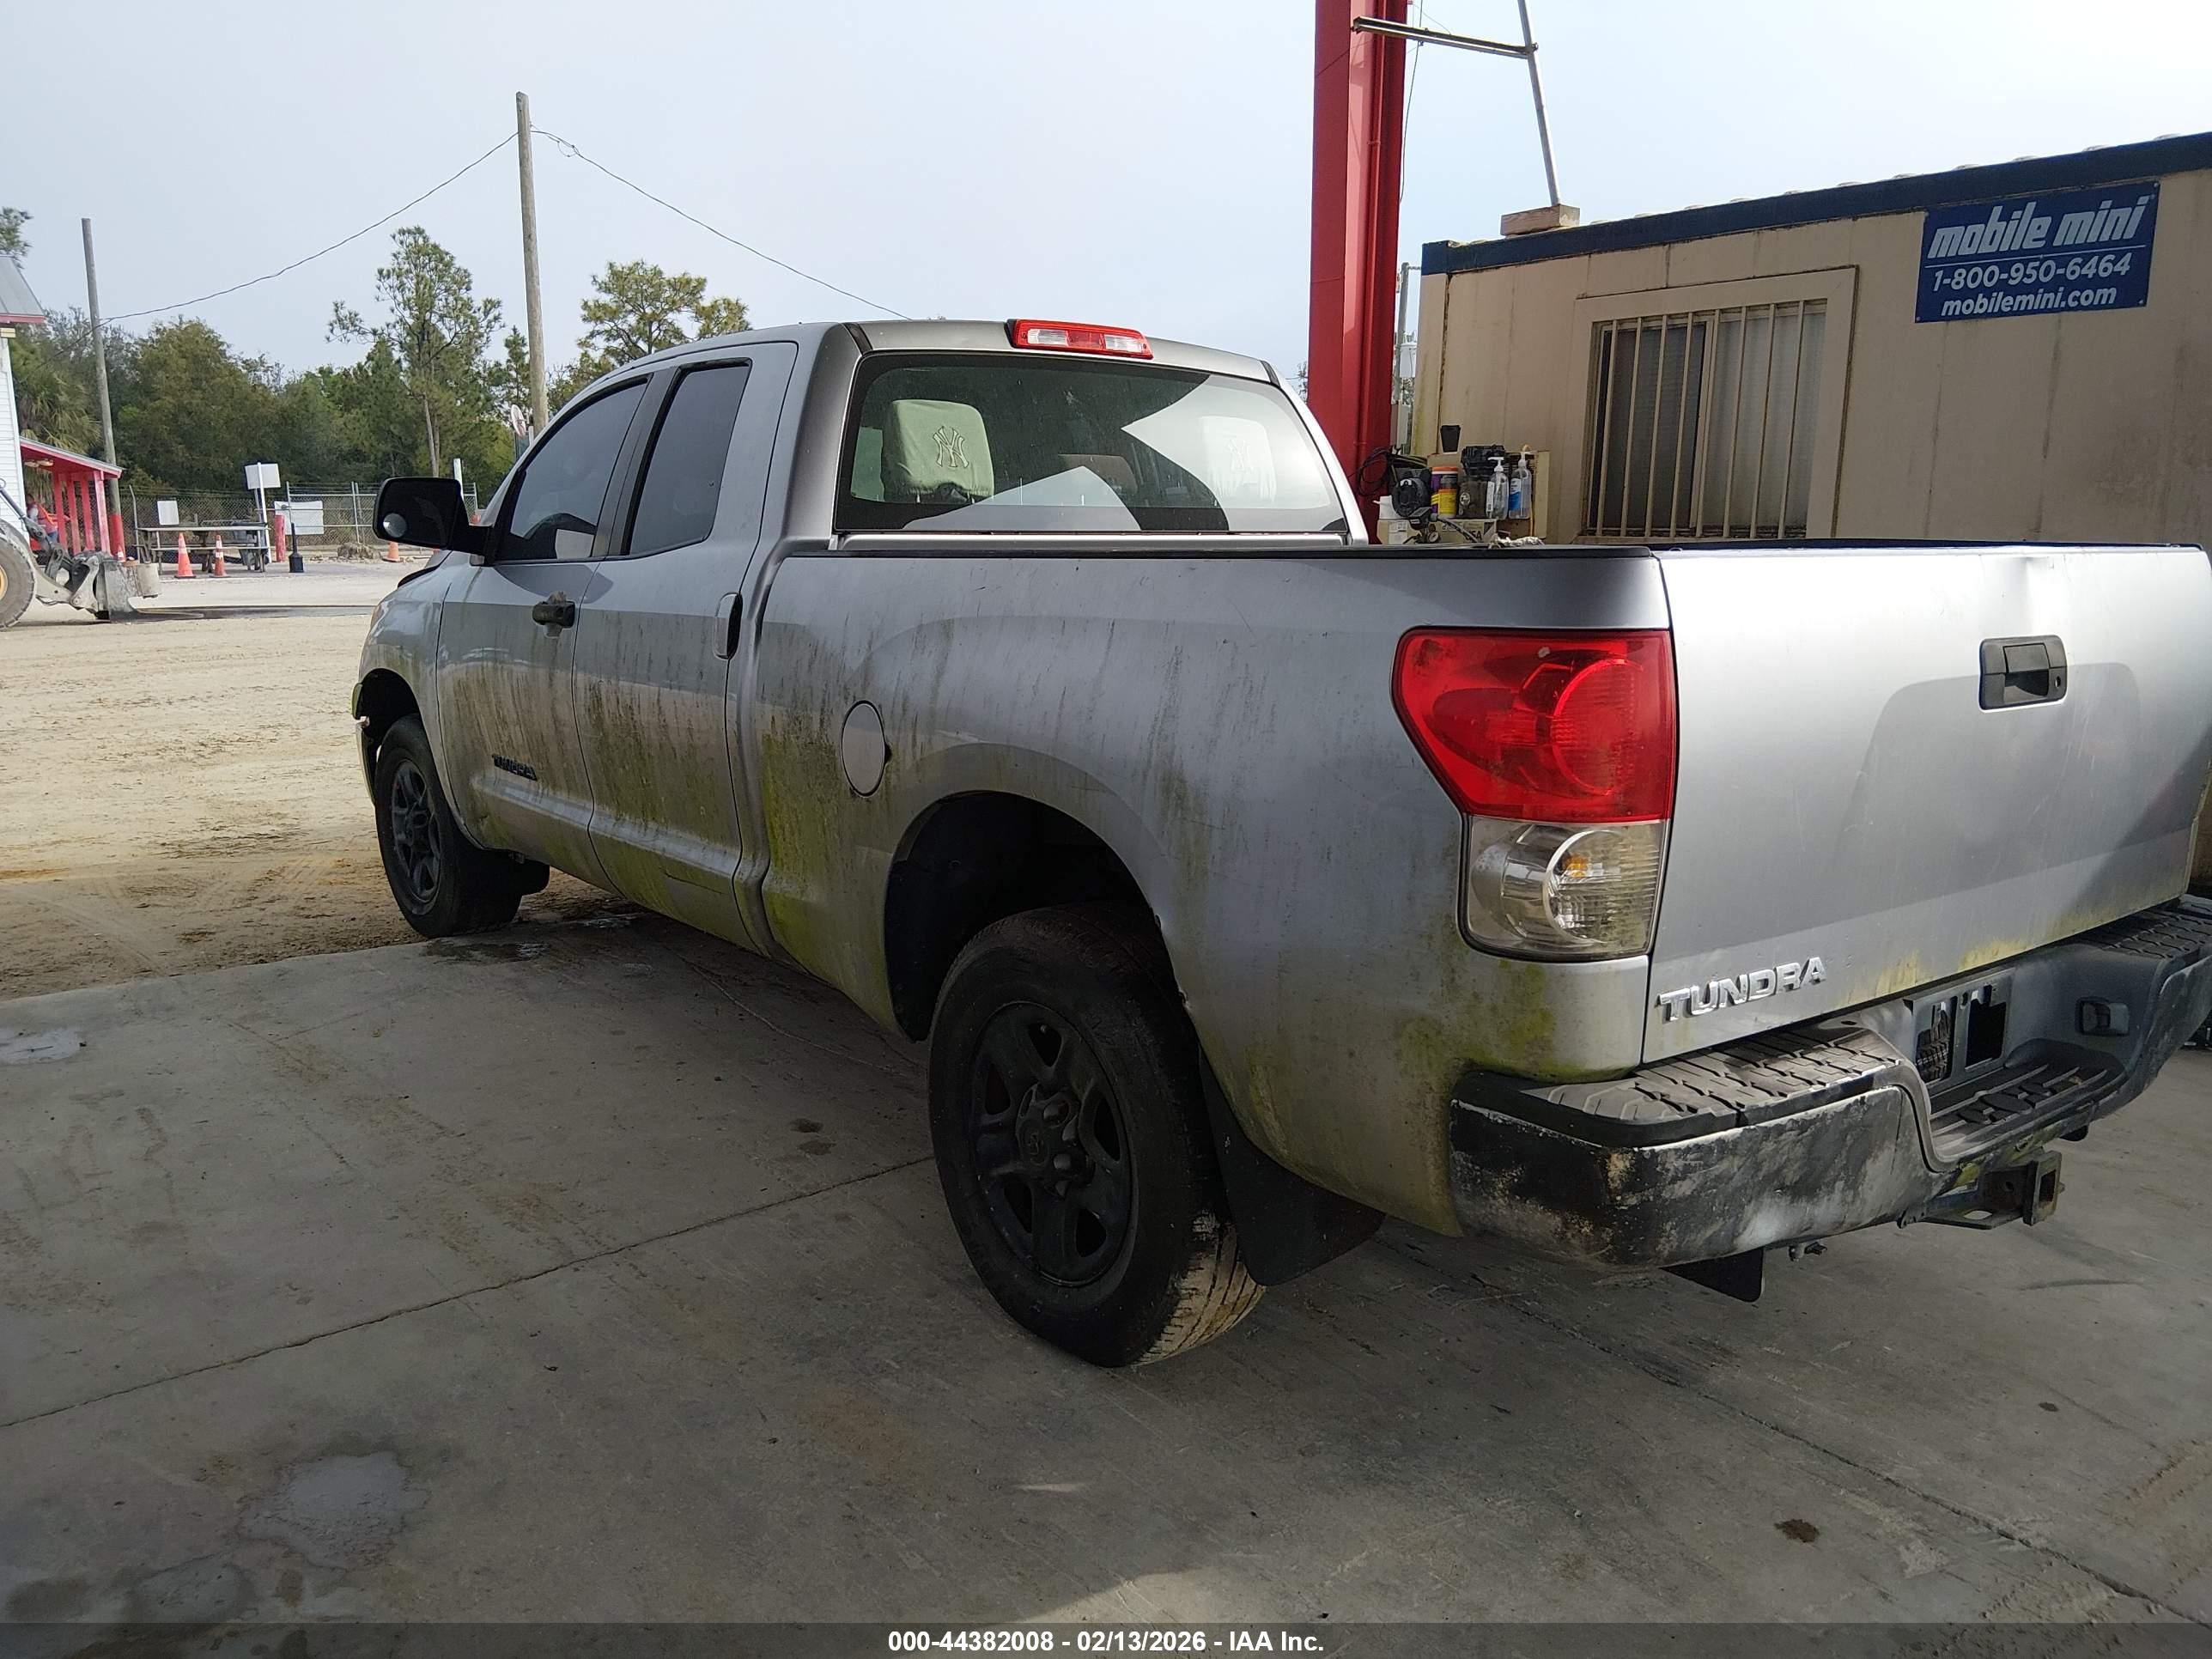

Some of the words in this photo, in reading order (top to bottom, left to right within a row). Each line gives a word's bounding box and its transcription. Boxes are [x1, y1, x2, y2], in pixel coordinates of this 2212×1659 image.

[1927, 201, 2052, 258] mobile
[2052, 195, 2151, 247] mini
[1933, 252, 2133, 292] 1-800-950-6464
[1941, 286, 2118, 317] mobilemini.com
[1656, 956, 1828, 1023] TUNDRA
